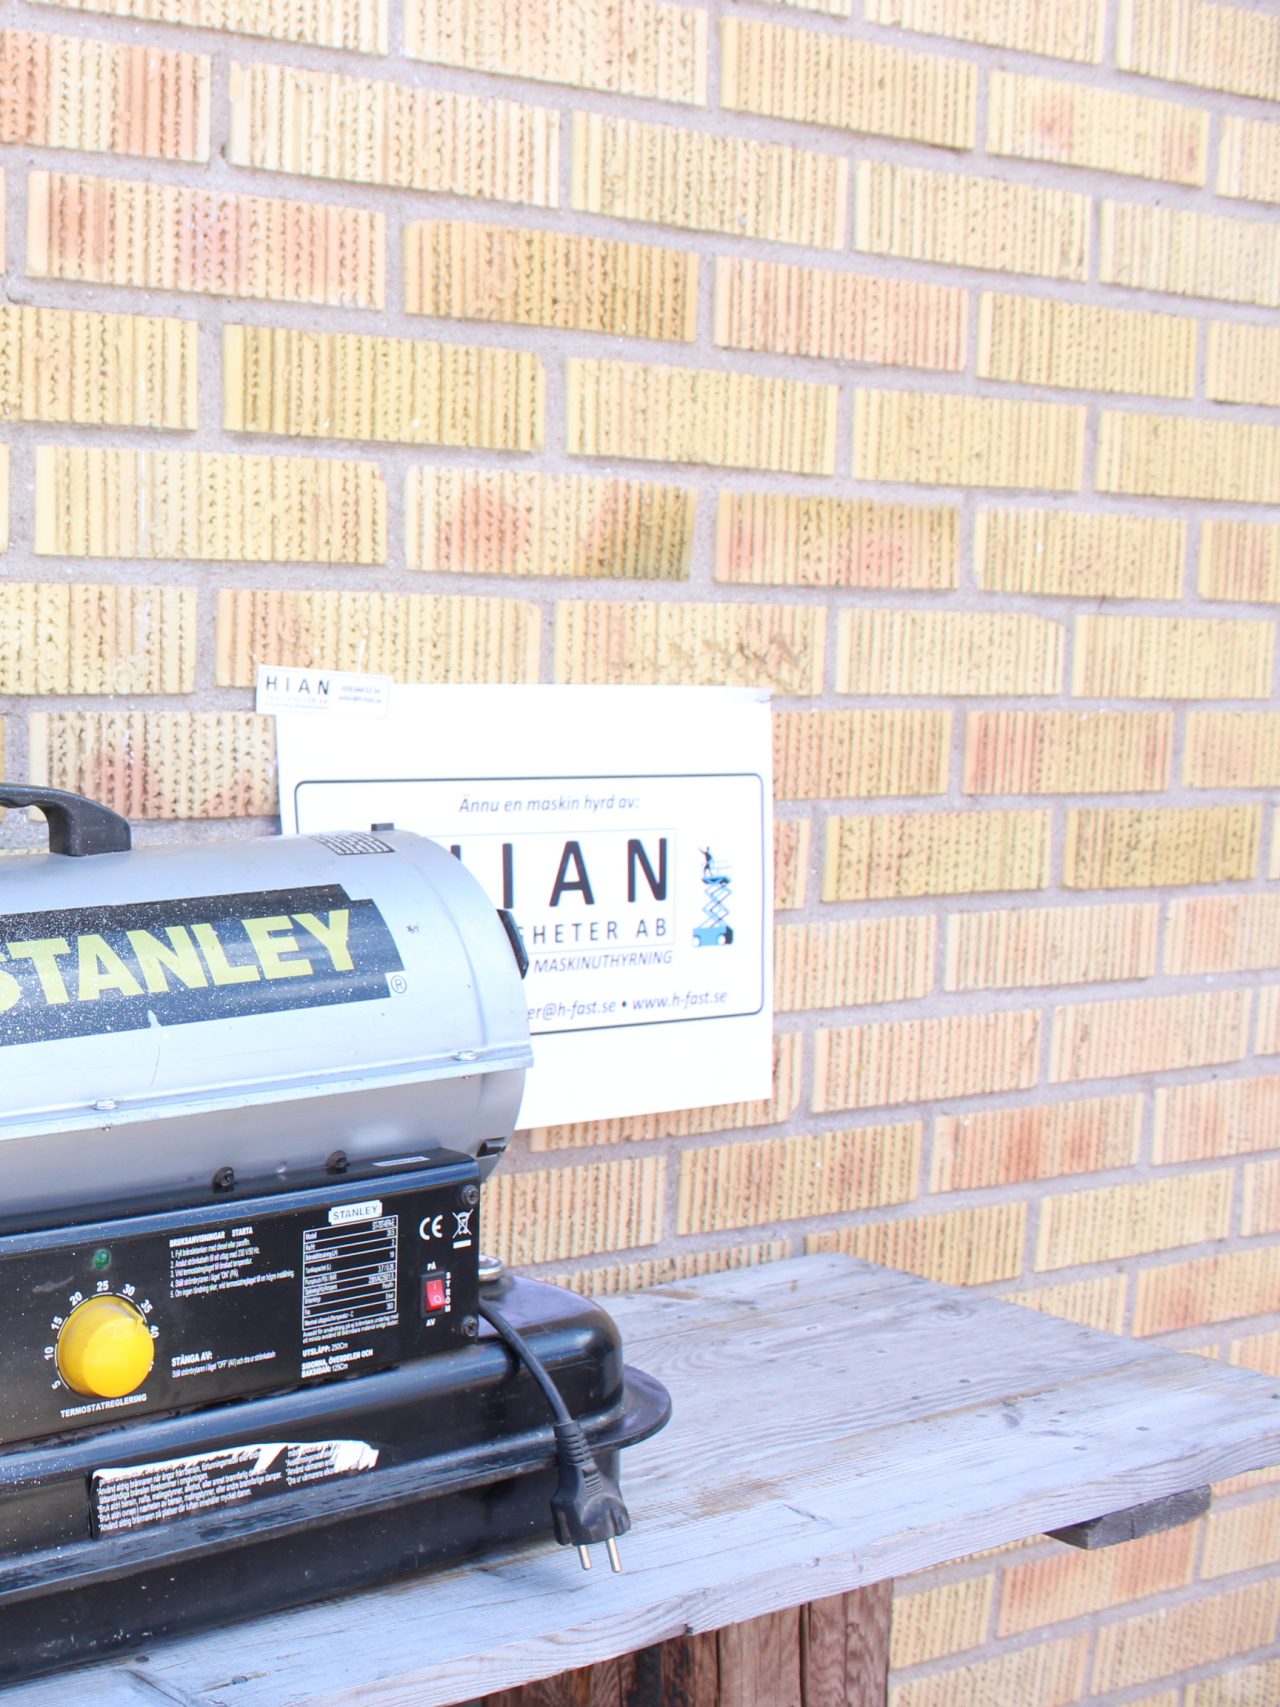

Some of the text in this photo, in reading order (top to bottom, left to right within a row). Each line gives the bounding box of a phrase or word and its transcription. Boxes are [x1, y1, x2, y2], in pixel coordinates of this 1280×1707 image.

[266, 675, 330, 696] HIAN
[459, 794, 640, 813] Ännu en maskin hyrd av:
[450, 838, 667, 909] IAN
[636, 918, 667, 938] AB
[534, 950, 673, 973] MASKINUTHYRNING
[633, 990, 728, 1010] www.h-fast.se
[333, 1205, 378, 1221] STANLEY
[169, 1227, 253, 1248] BRUKSANVISNINGAR STARTA
[427, 1261, 436, 1271] PÅ
[96, 1280, 109, 1292] 25
[122, 1284, 135, 1296] 30
[69, 1292, 83, 1306] 20
[140, 1299, 153, 1313] 35
[51, 1316, 63, 1331] 15
[426, 1318, 436, 1327] AV
[150, 1325, 159, 1339] 40
[44, 1346, 54, 1360] 10
[171, 1350, 213, 1366] STÄNGA AV:
[361, 1349, 373, 1359] OCH
[51, 1379, 61, 1390] 5
[60, 1393, 147, 1418] TERMOSTATREGLERING
